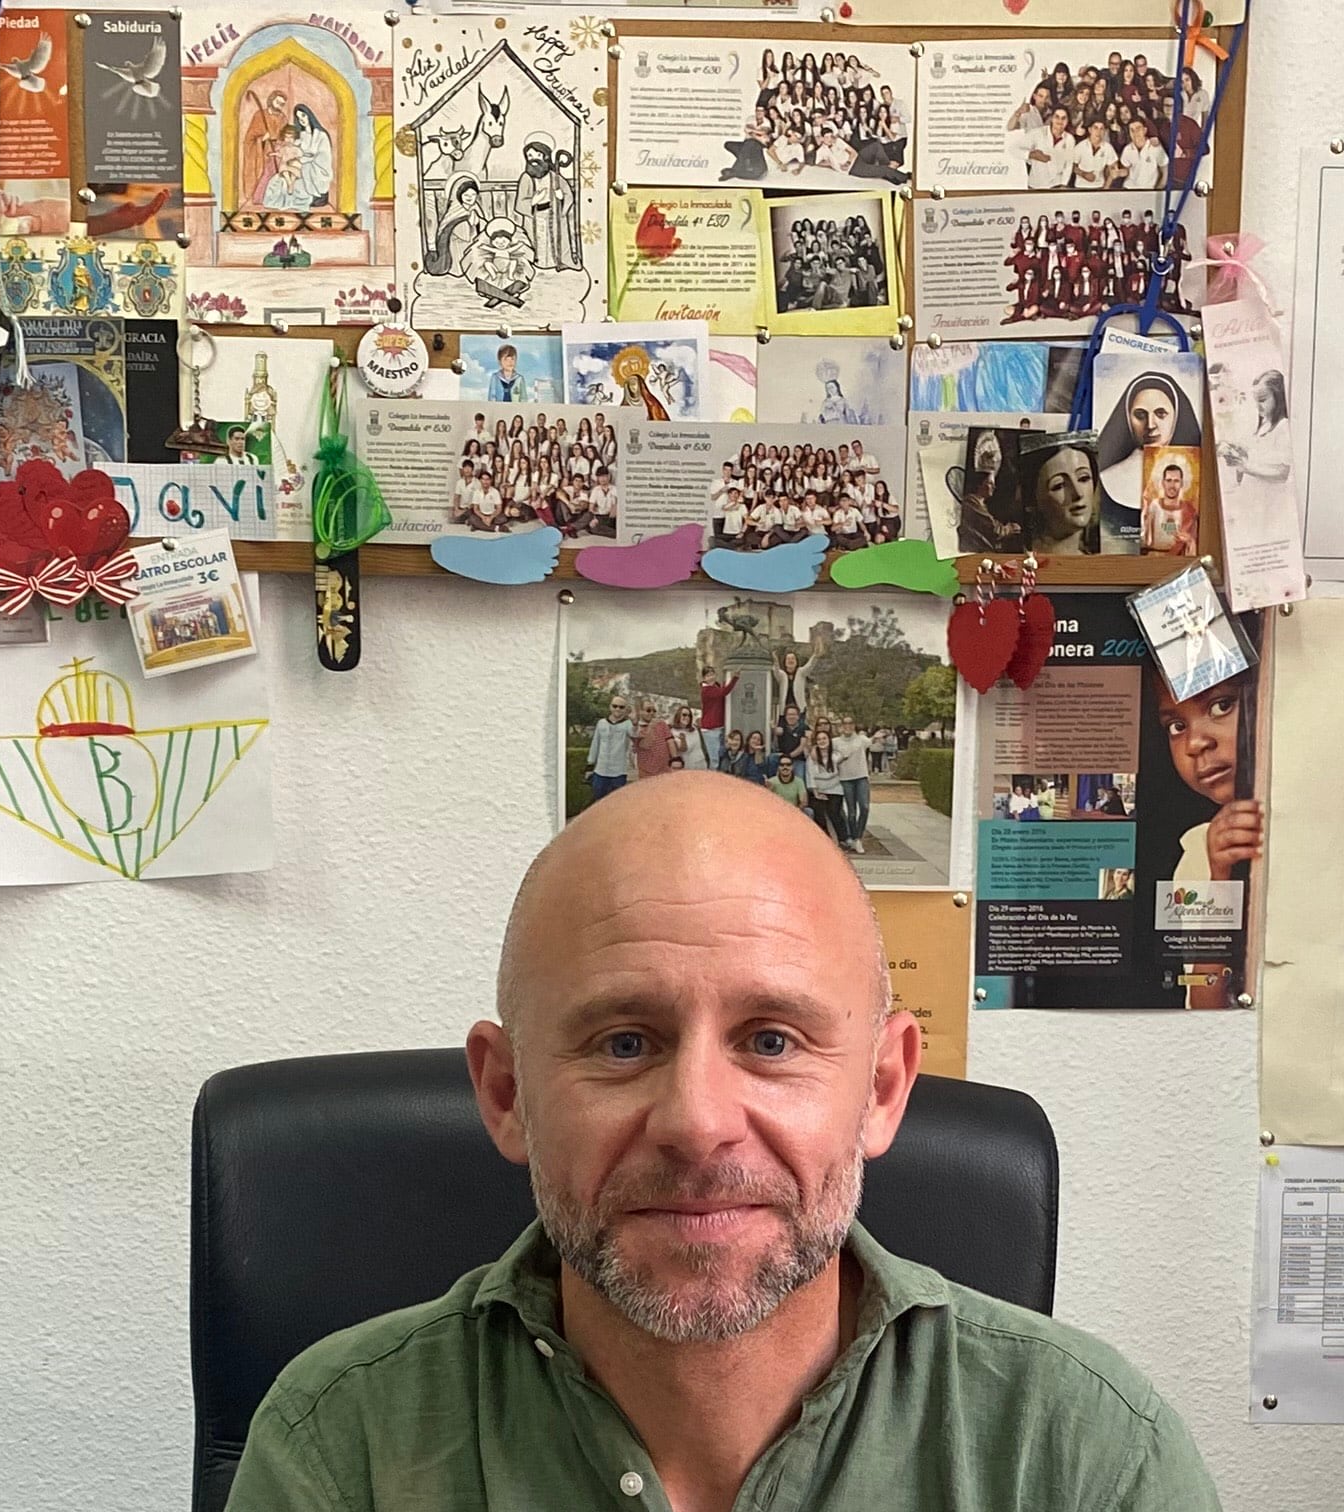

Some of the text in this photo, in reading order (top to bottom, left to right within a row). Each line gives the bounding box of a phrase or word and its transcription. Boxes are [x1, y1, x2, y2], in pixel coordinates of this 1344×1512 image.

[103, 20, 162, 35] Sabiduría
[523, 25, 575, 61] Happy
[636, 149, 709, 168] Invitación
[936, 158, 1009, 175] Invitación
[707, 214, 730, 228] ESO
[655, 300, 720, 320] Invitación
[125, 333, 166, 344] GRACIA
[367, 360, 419, 379] MAESTRO
[173, 552, 227, 572] ESCOLAR
[198, 570, 219, 584] 3€
[1101, 639, 1147, 657] 2016
[90, 736, 134, 833] B
